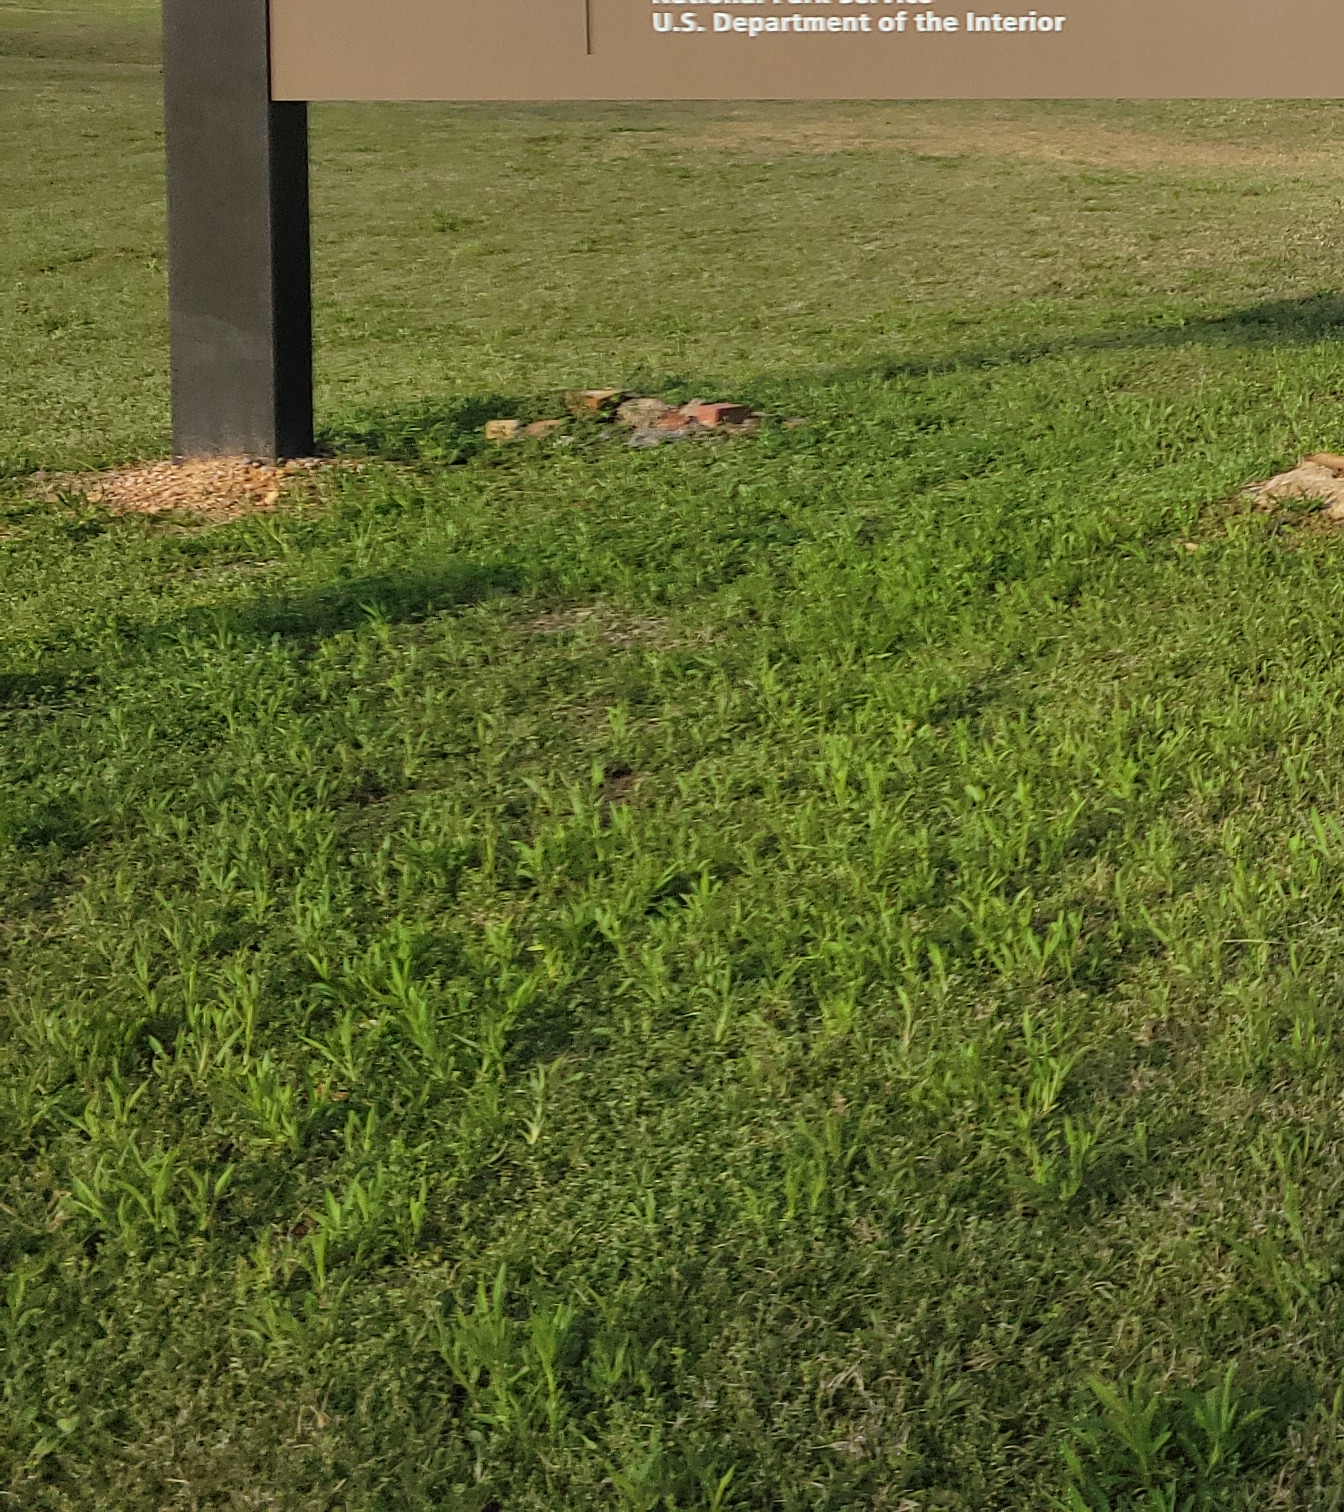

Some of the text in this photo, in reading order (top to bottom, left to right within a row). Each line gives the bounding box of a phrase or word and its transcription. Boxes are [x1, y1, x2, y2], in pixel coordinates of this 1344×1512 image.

[653, 11, 1066, 37] U.S. Department of the Interior
